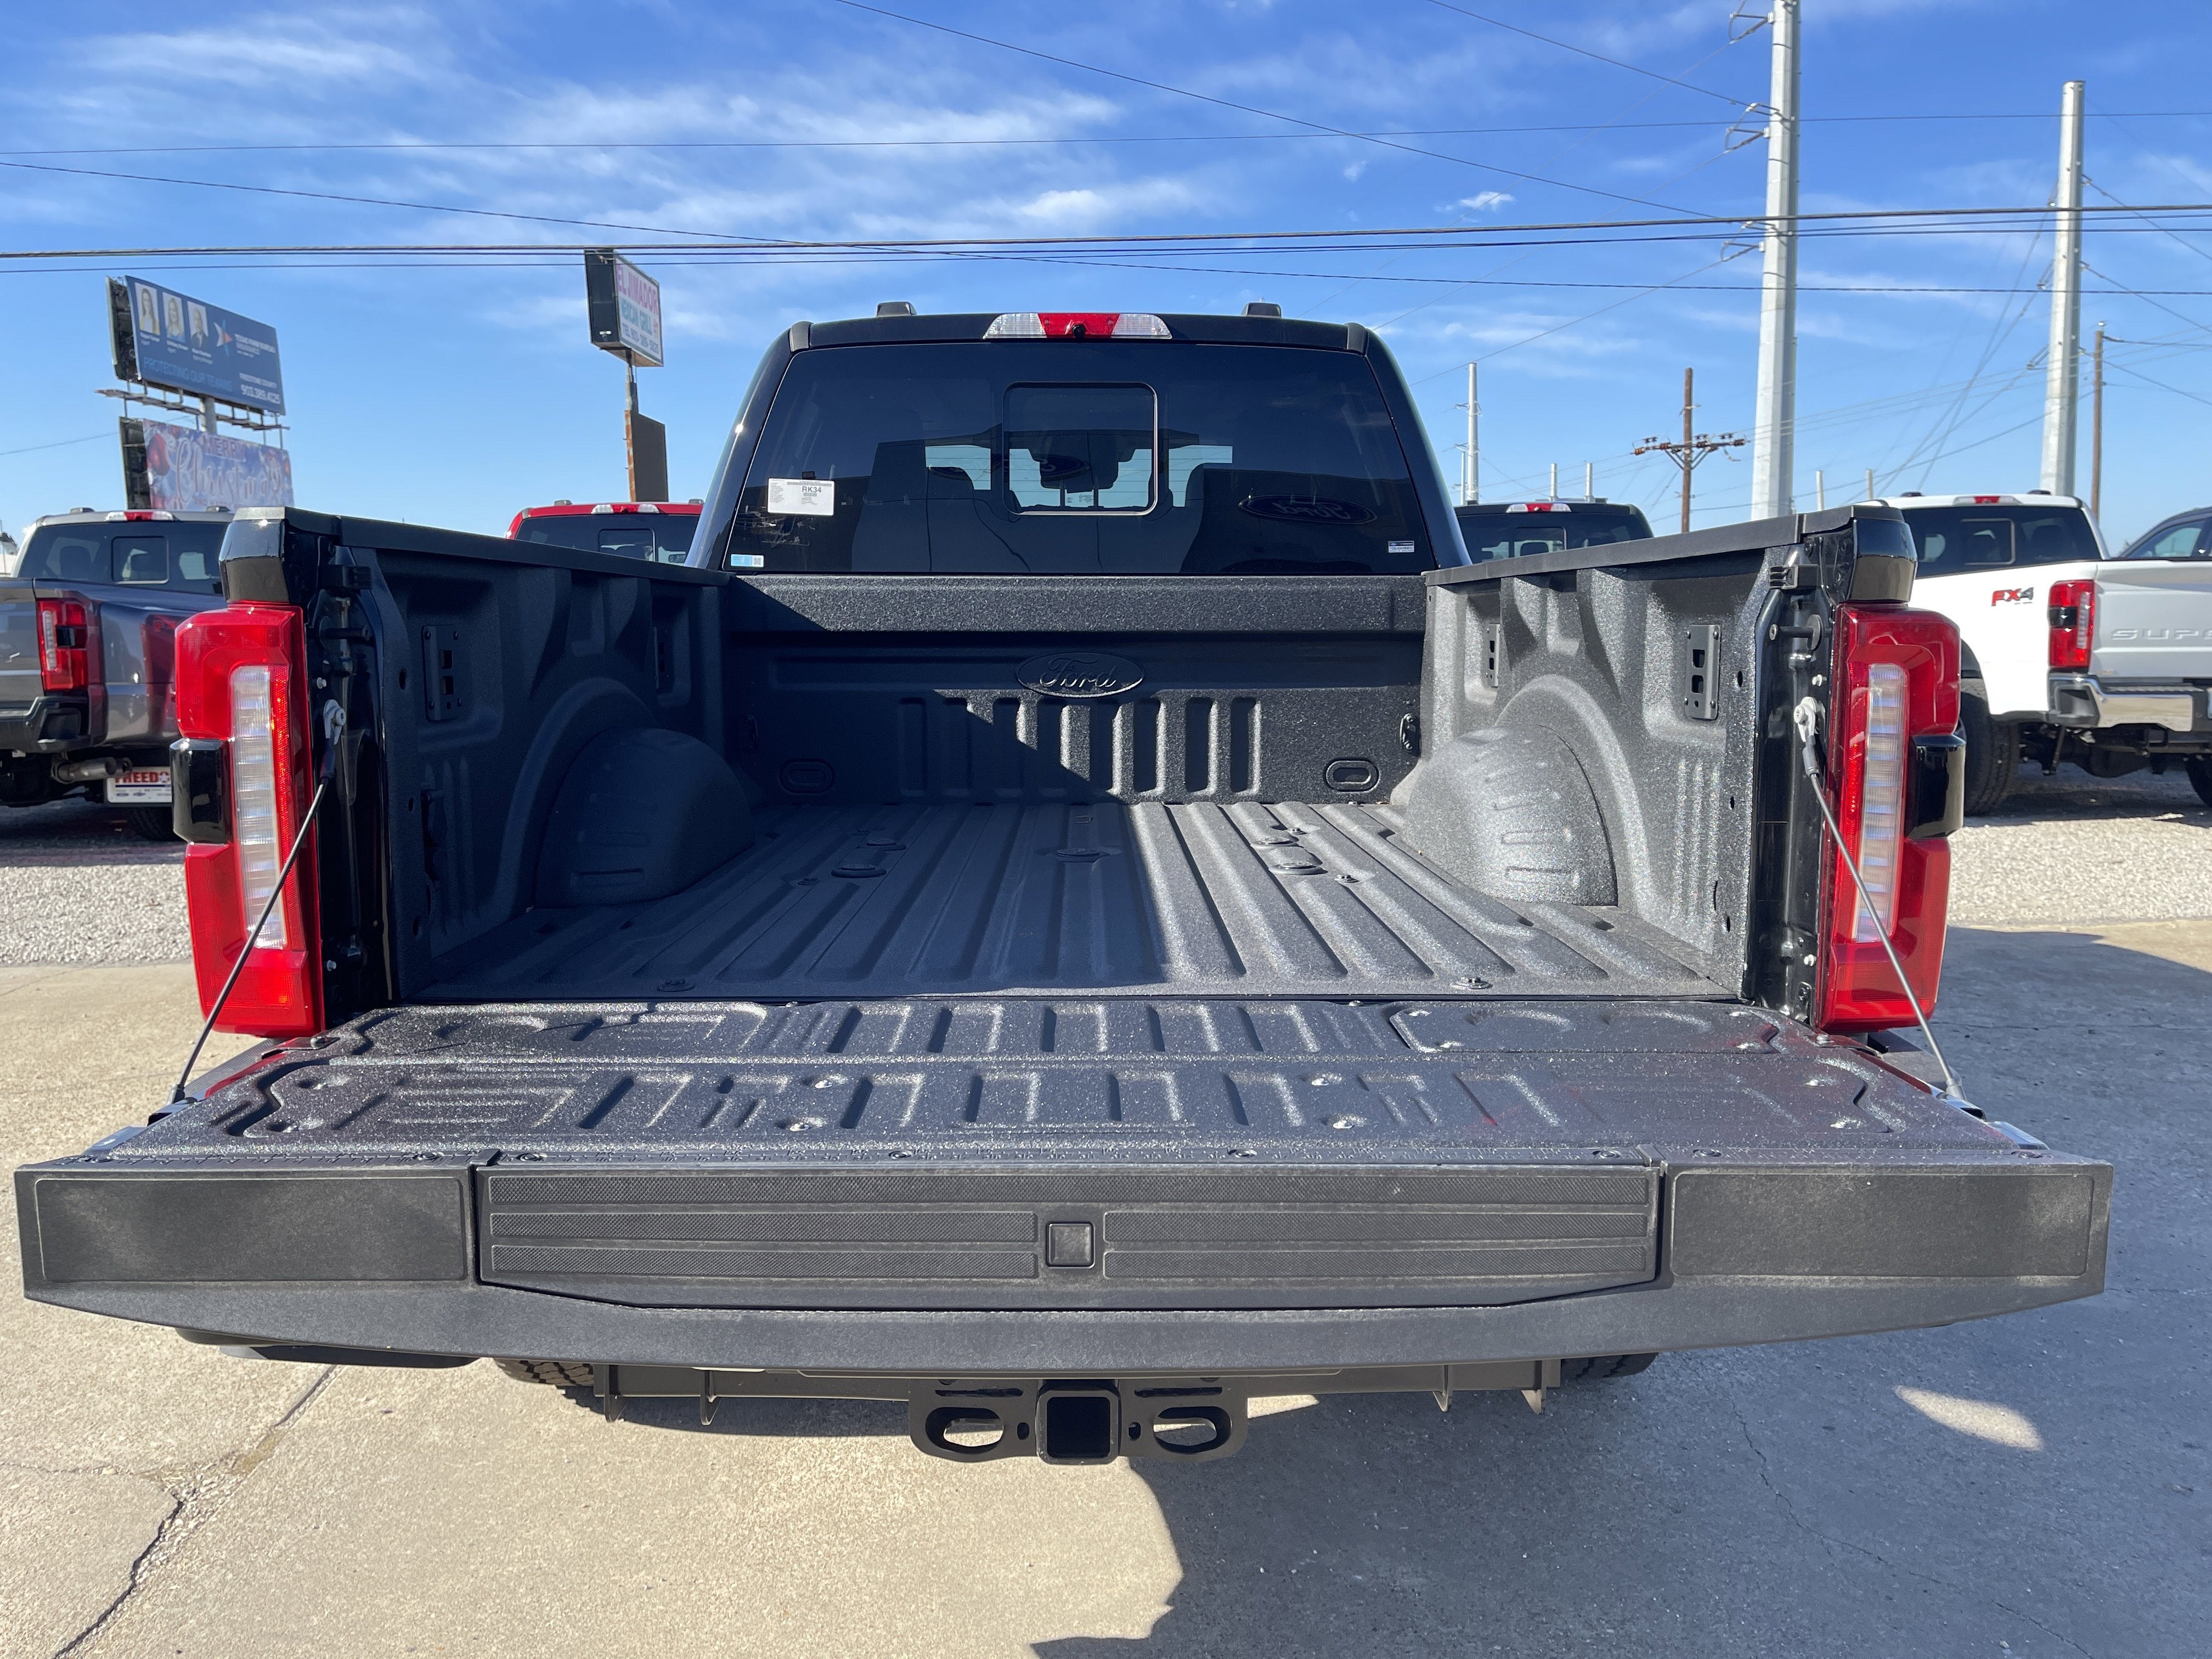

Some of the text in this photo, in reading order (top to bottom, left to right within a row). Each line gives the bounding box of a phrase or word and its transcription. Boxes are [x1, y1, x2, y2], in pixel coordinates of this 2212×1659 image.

[616, 263, 658, 315] EL JIMADOR
[622, 323, 630, 338] TEL
[640, 310, 653, 336] GRILL
[143, 357, 189, 380] PROTECTING
[202, 435, 246, 462] MERRY
[166, 437, 281, 506] Christmas
[1991, 587, 2034, 606] FX4
[1040, 658, 1118, 687] Ford
